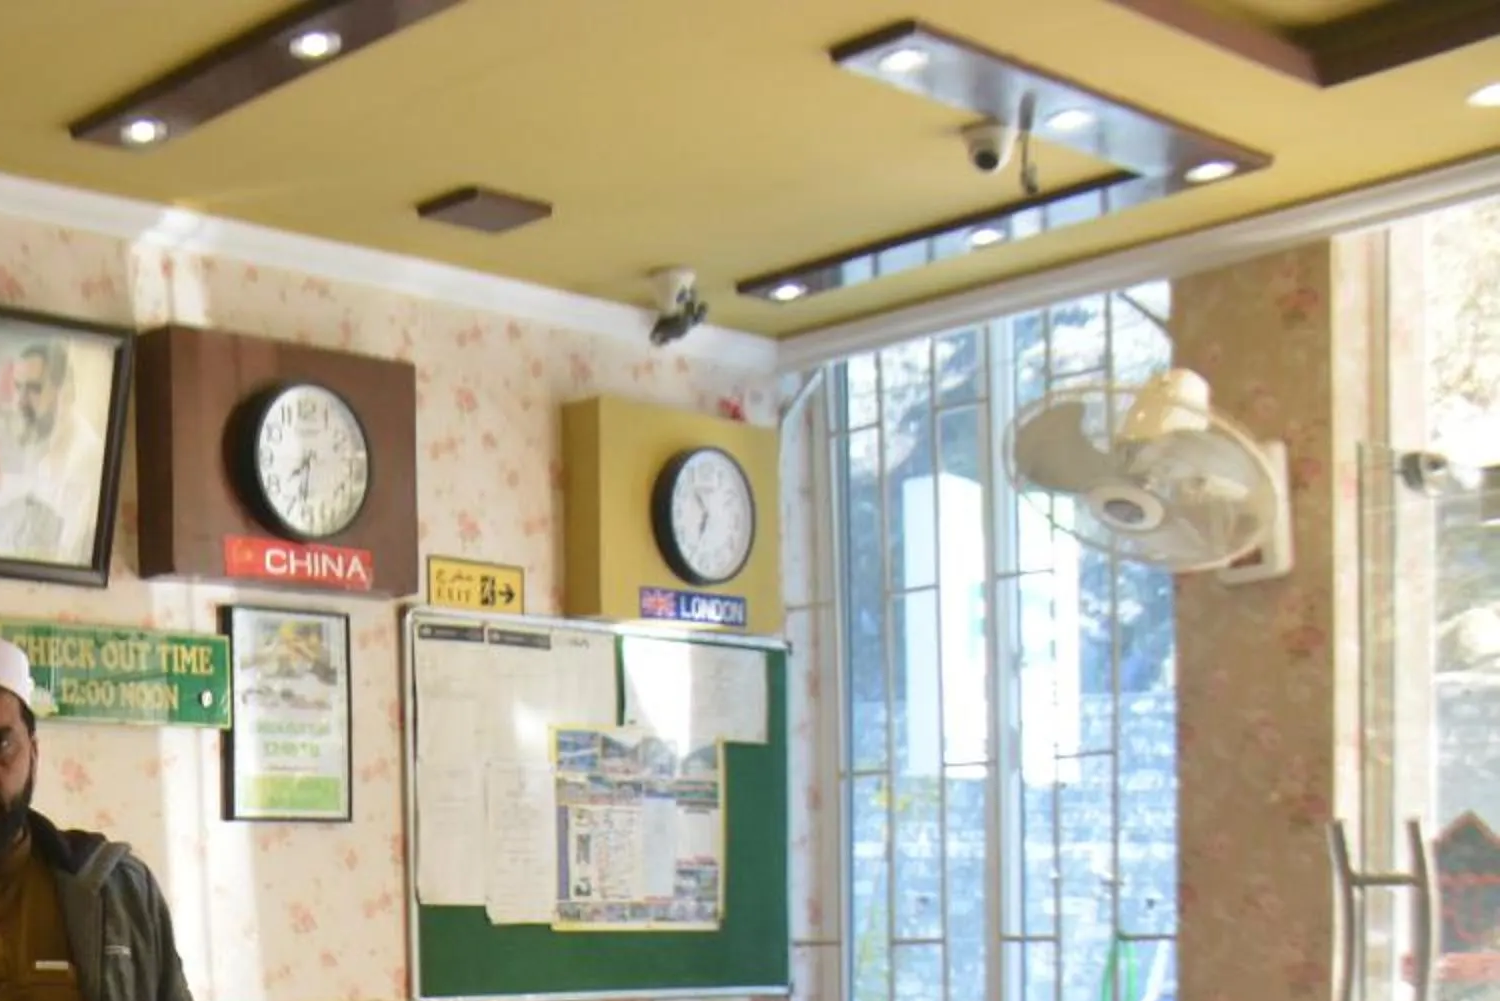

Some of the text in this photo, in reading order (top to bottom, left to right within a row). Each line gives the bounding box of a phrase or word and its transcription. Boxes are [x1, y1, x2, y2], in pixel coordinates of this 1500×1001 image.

[265, 548, 367, 582] CHINA
[680, 595, 744, 624] LONDON
[102, 638, 150, 673] OUT
[160, 643, 215, 676] TIME
[61, 677, 179, 710] 12:00 NOON
